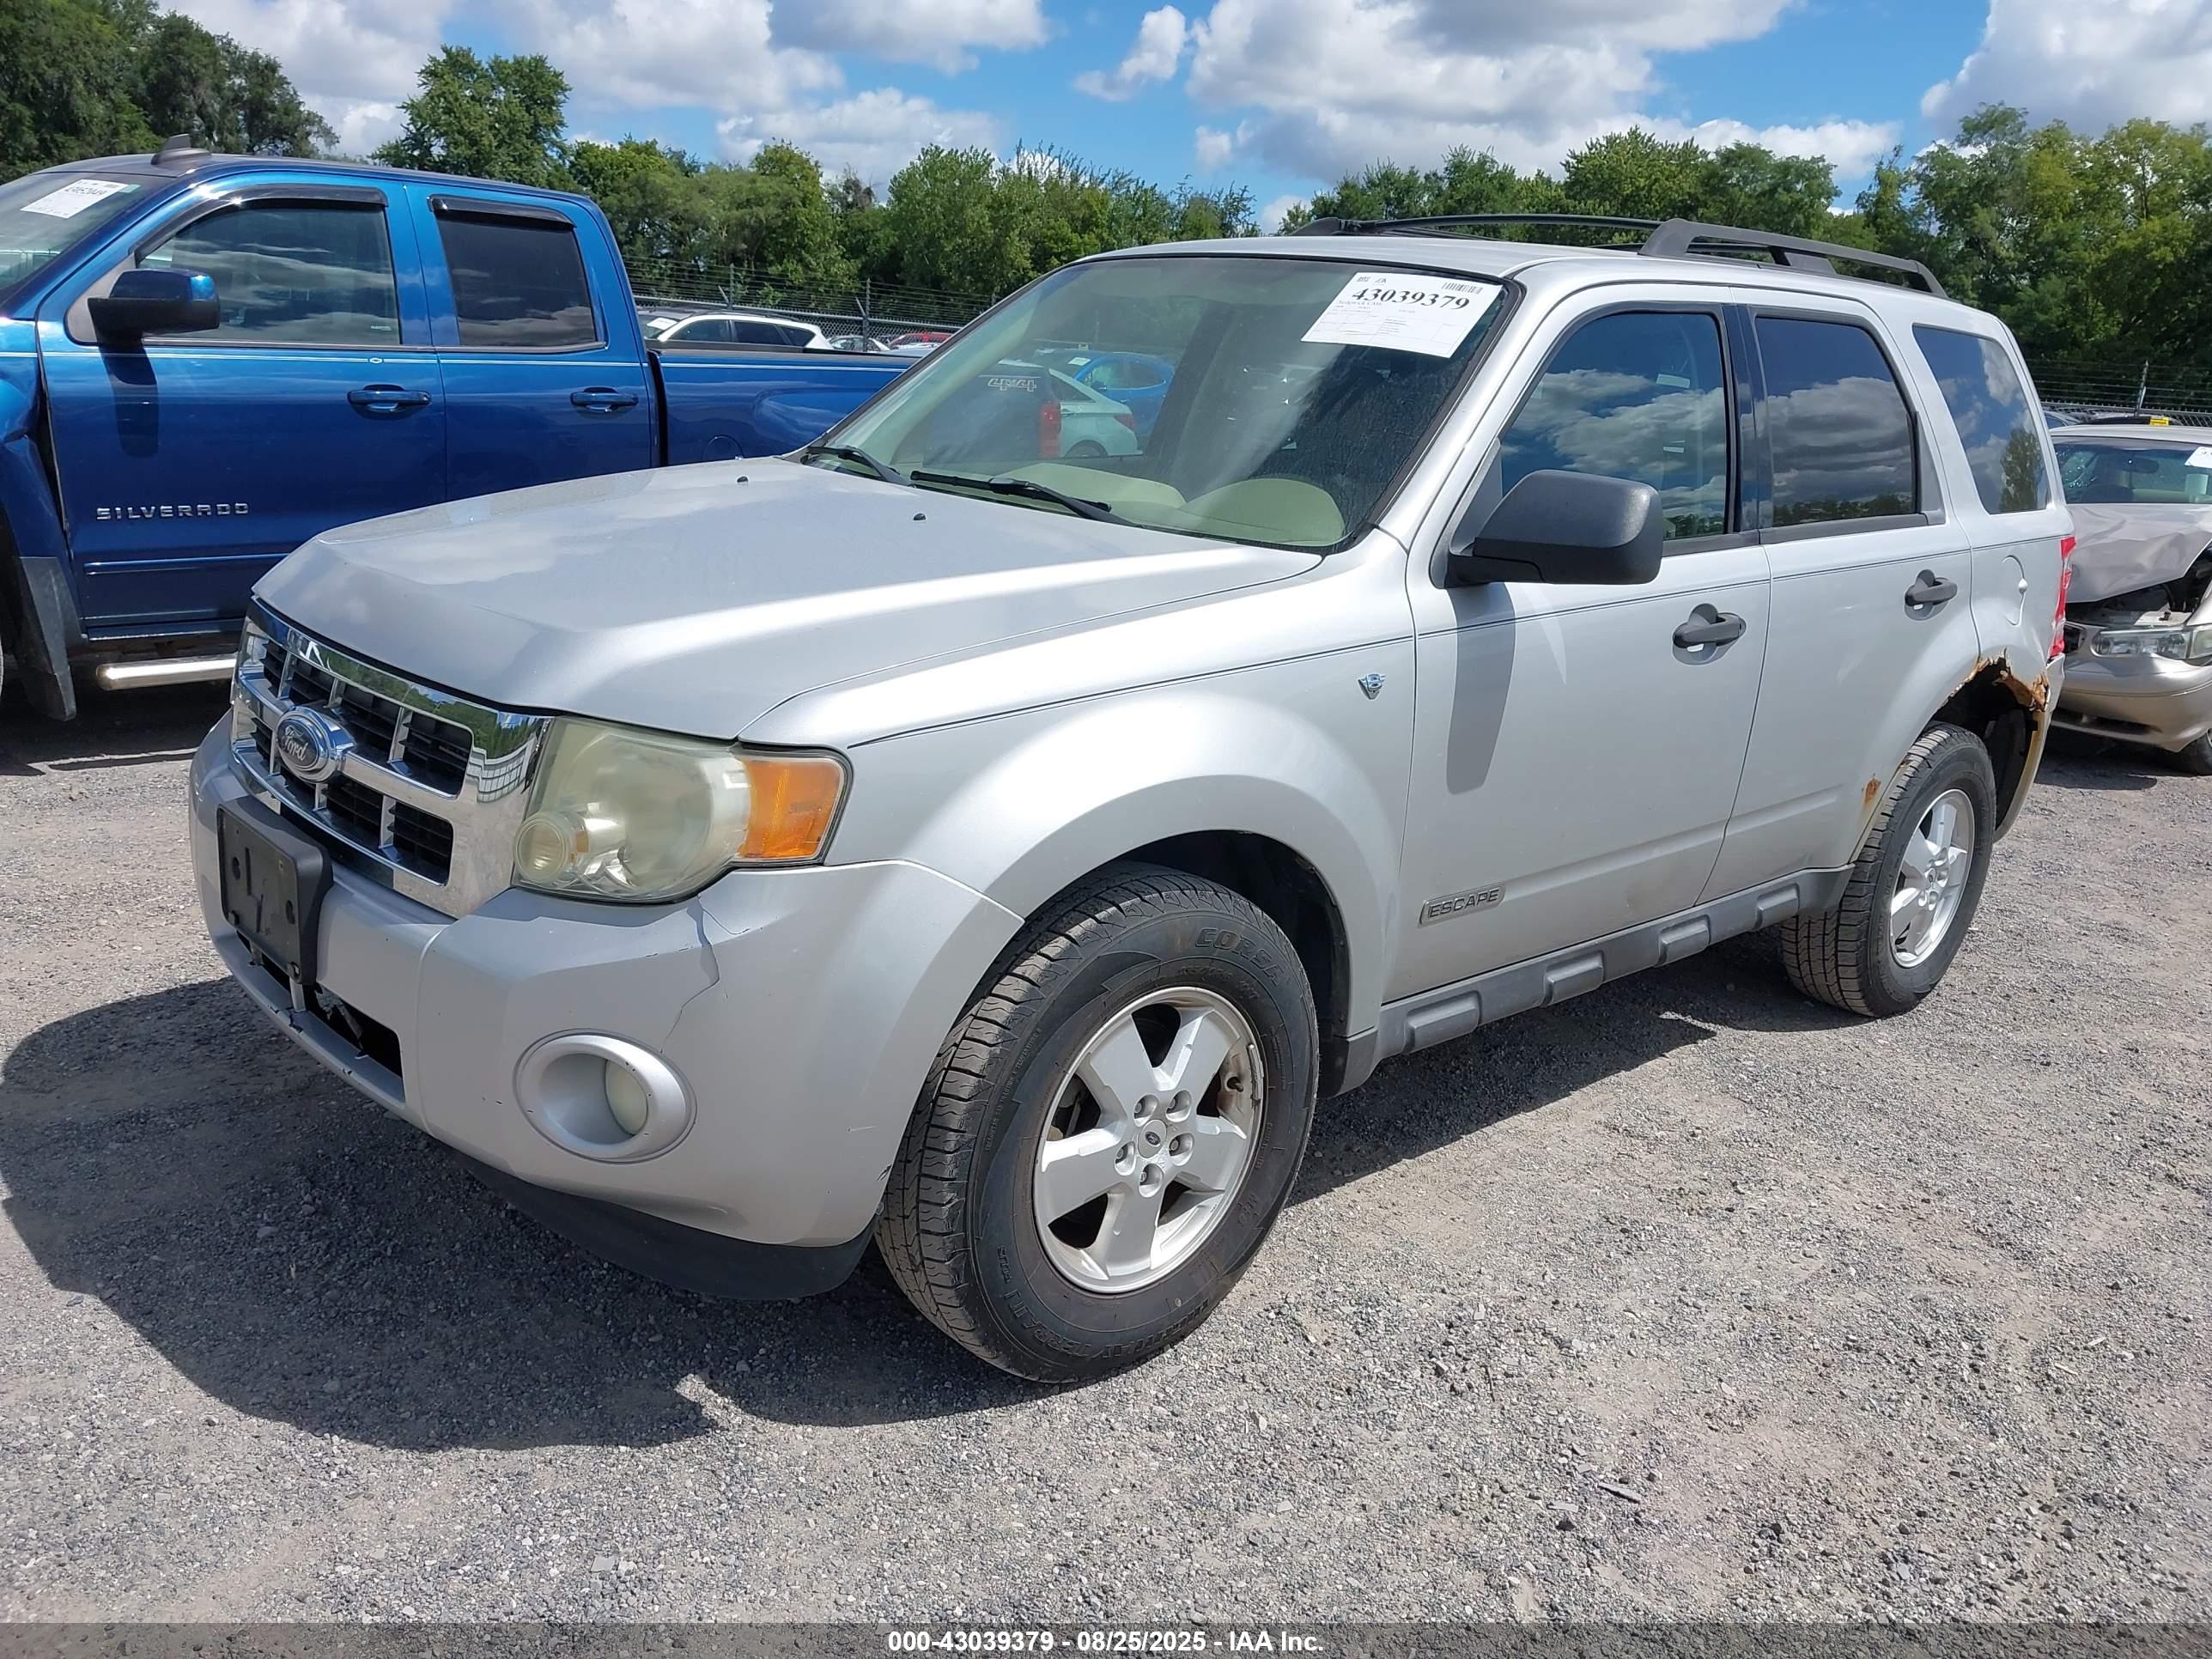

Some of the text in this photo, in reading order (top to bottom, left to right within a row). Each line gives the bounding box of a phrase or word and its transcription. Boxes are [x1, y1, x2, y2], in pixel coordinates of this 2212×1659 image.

[1352, 287, 1470, 310] 43039379
[96, 502, 248, 520] SILVERADO
[282, 726, 309, 762] Ford
[1429, 886, 1499, 919] ESCAPE
[1194, 927, 1285, 988] CORSA
